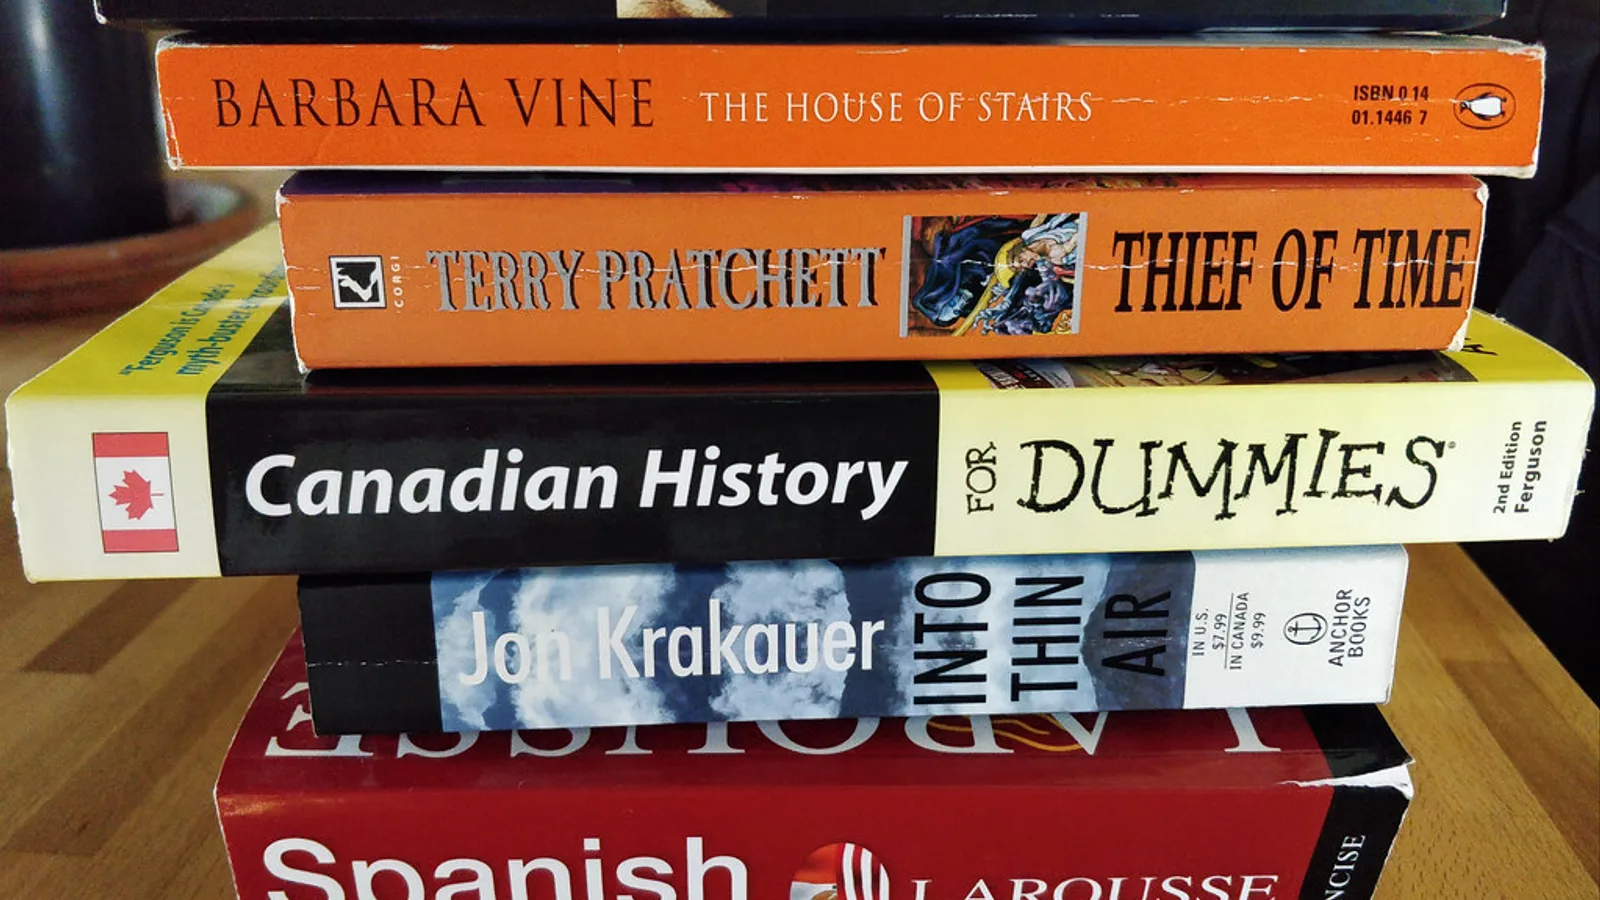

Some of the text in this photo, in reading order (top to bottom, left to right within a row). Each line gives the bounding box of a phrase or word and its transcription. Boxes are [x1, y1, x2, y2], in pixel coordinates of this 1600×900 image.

[213, 78, 655, 127] BARBARA VINE
[699, 91, 1094, 123] THE HOUSE OF STAIRS
[1353, 84, 1429, 101] ISBN 0 14
[1419, 109, 1428, 125] 7
[390, 255, 405, 309] CORGI
[425, 246, 887, 312] TERRY PRATCHETT
[1111, 228, 1472, 313] THIEF OF TIME
[176, 309, 252, 376] myth-buster
[245, 445, 909, 521] Canadian History
[966, 441, 997, 514] FOR
[1493, 421, 1522, 515] 2nd Edition
[1514, 420, 1547, 513] Ferguson
[459, 599, 885, 687] Jon Krakauer
[913, 572, 991, 705] INTO
[1010, 576, 1084, 701] THIN
[1101, 590, 1171, 676] AIR
[1192, 607, 1209, 656] IN U.S.
[1212, 613, 1228, 650] $7.99
[1229, 591, 1250, 670] IN CANADA
[1250, 612, 1266, 649] $9.99
[1328, 588, 1353, 667] ANCHOR
[1347, 596, 1371, 658] BOOKS
[262, 836, 748, 900] Spanish
